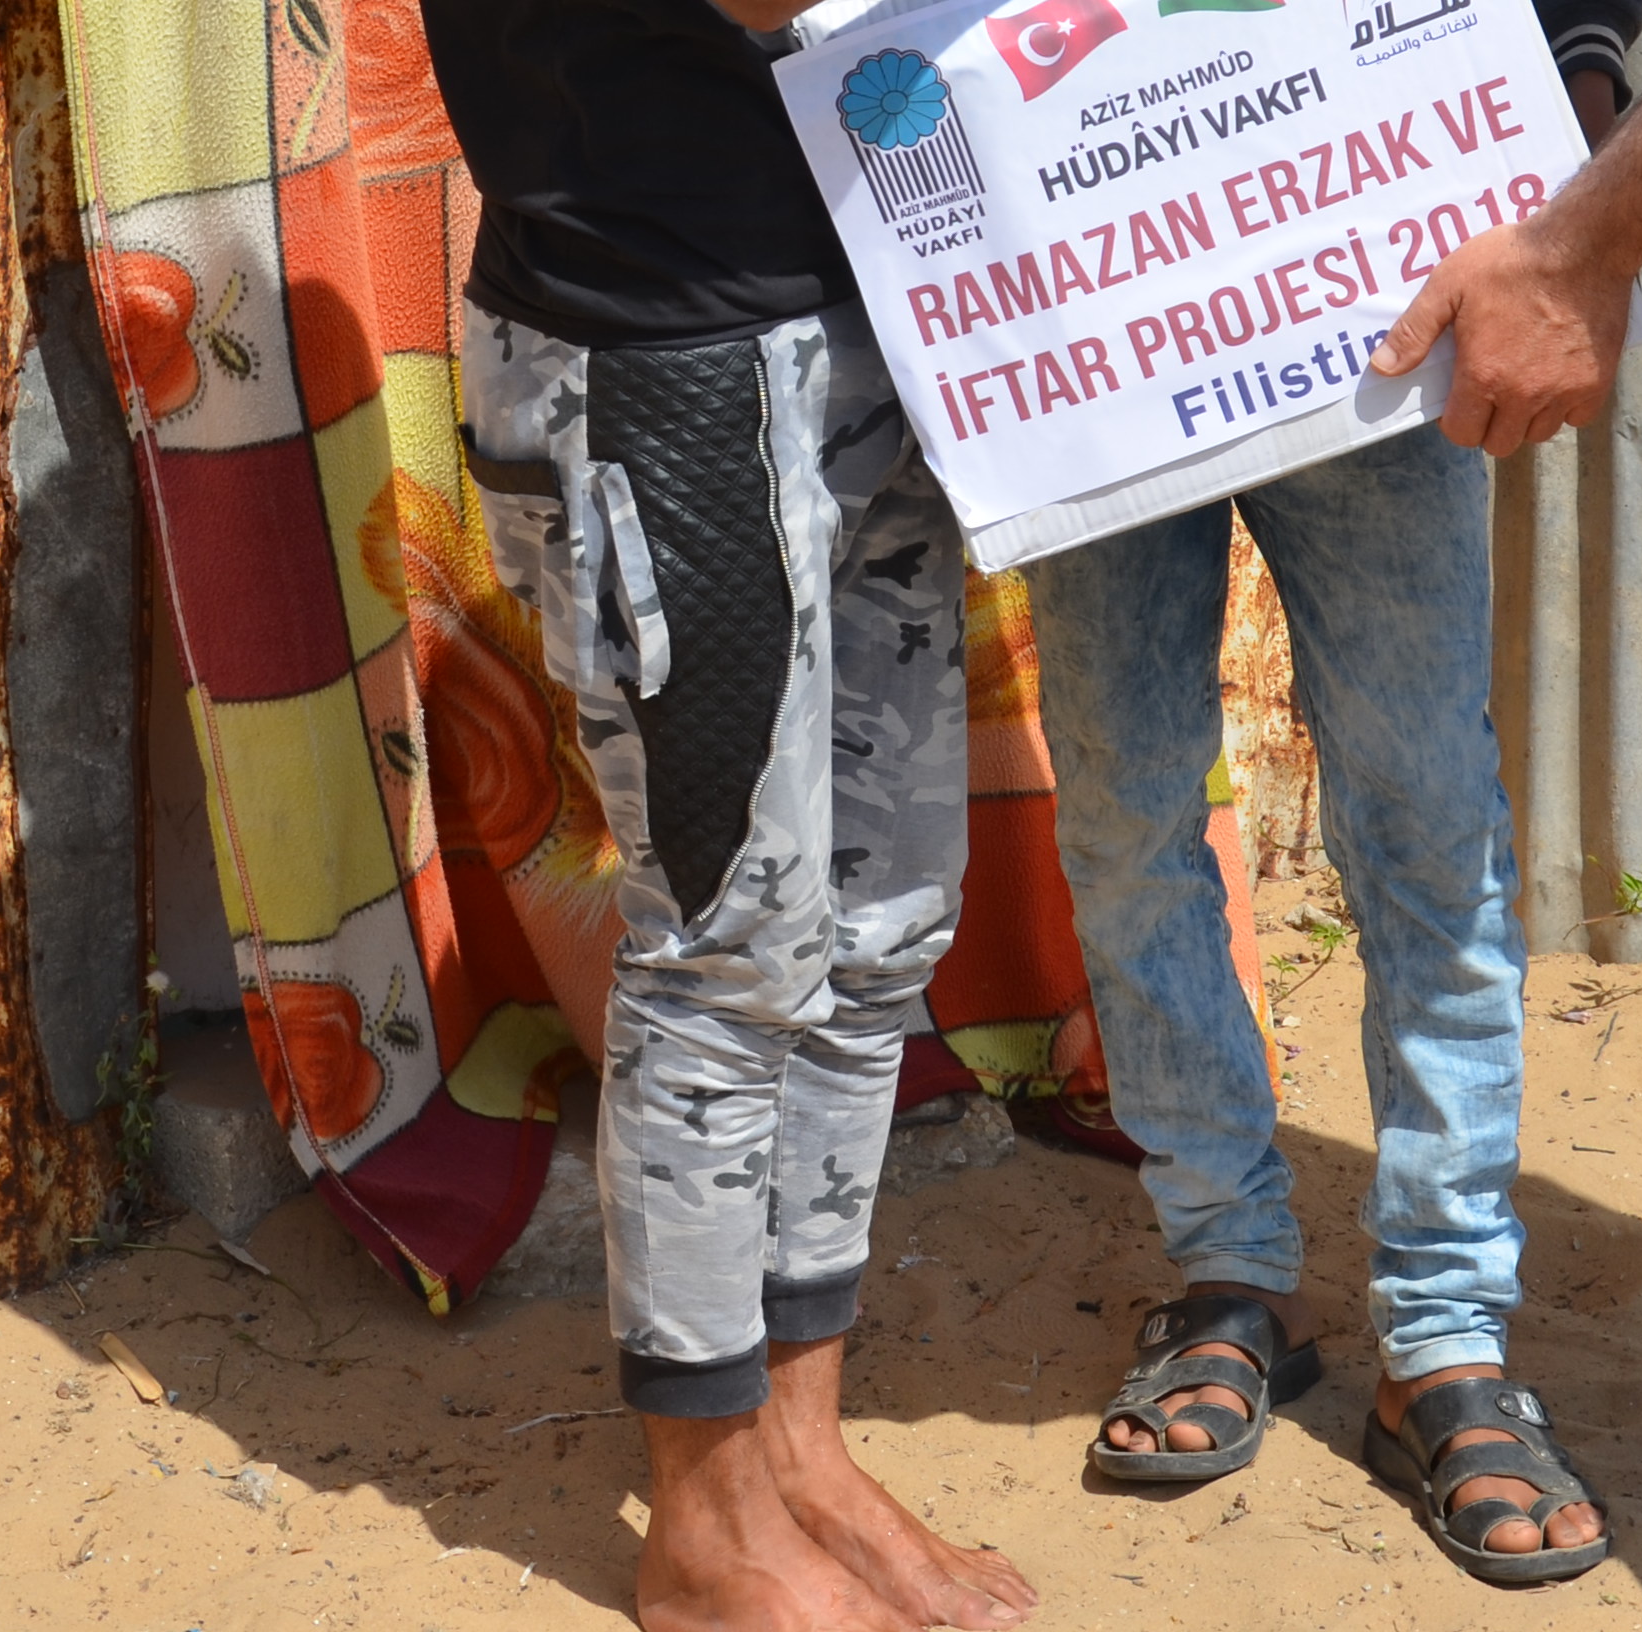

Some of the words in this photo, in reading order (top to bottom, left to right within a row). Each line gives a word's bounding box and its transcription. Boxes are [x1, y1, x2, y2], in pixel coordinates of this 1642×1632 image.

[1080, 94, 1135, 131] AZİZ
[1138, 50, 1254, 108] MAHMÛD
[1356, 38, 1421, 67] والتنمية
[1038, 105, 1200, 202] HÜDÂYİ
[1200, 67, 1327, 139] VAKFI
[906, 191, 1216, 347] RAMAZAN
[1221, 110, 1433, 238] ERZAK
[1432, 76, 1525, 155] VE
[913, 225, 983, 258] VAKFI
[935, 336, 1121, 442] İFTAR
[1125, 227, 1379, 380] PROJESİ
[1388, 173, 1548, 283] 2018
